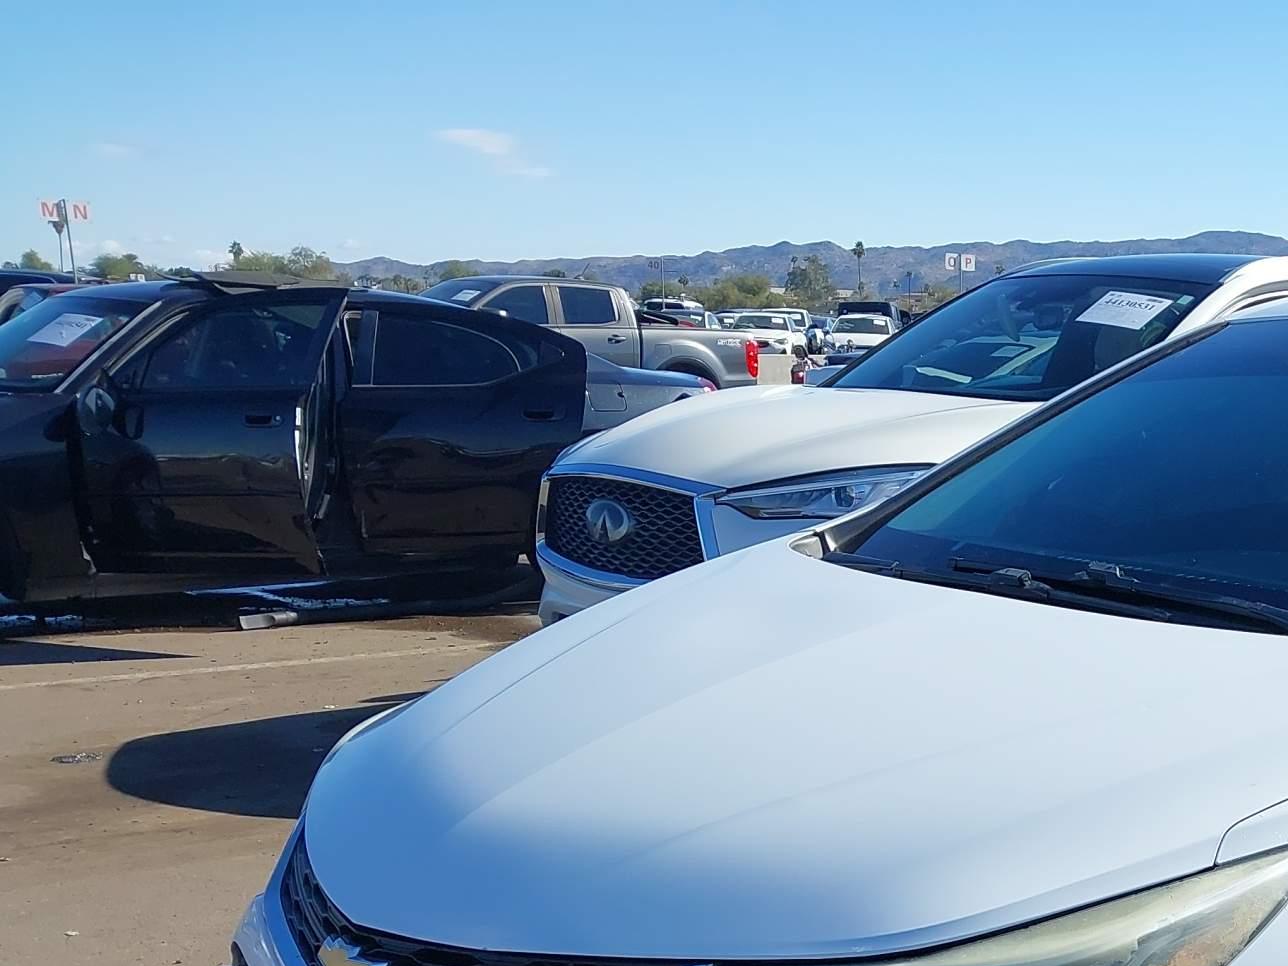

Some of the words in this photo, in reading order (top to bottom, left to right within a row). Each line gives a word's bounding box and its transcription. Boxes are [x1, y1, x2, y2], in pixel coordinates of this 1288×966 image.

[41, 202, 59, 217] M
[73, 204, 87, 219] N
[965, 257, 972, 269] P
